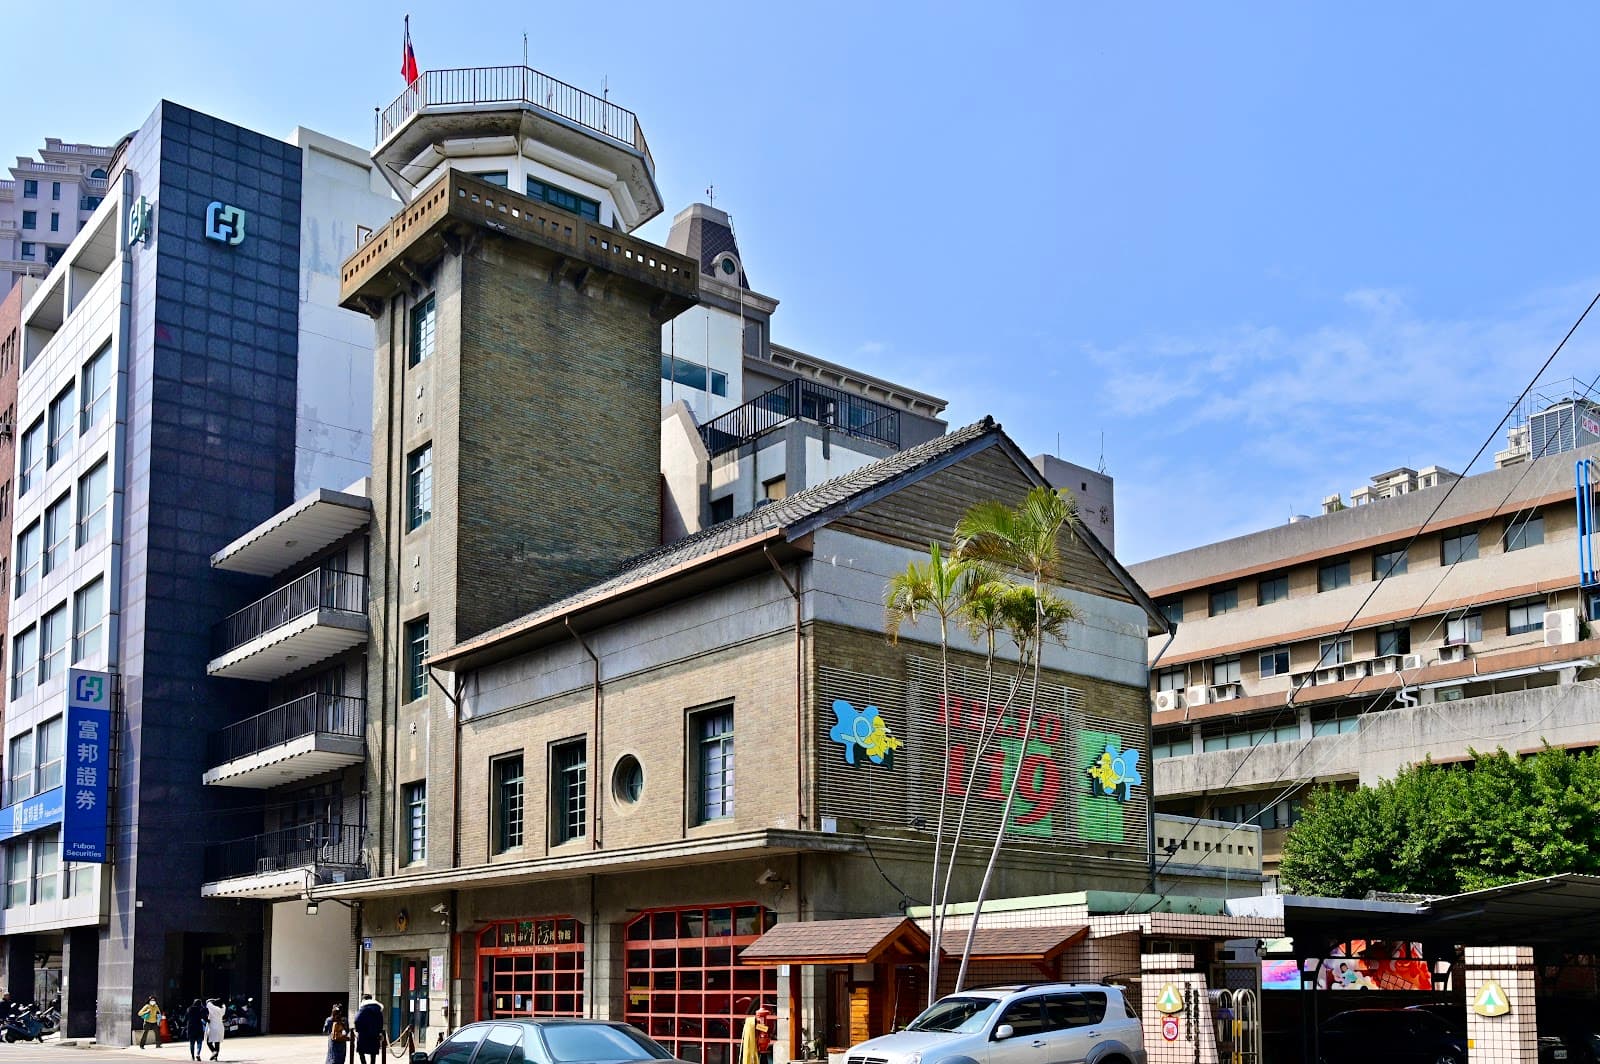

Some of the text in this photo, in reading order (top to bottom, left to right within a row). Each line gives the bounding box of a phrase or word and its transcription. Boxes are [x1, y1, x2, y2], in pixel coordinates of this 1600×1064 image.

[76, 720, 99, 810] 富邦證券
[937, 743, 1061, 825] 119
[66, 849, 102, 858] Securities
[73, 842, 96, 850] Fubon
